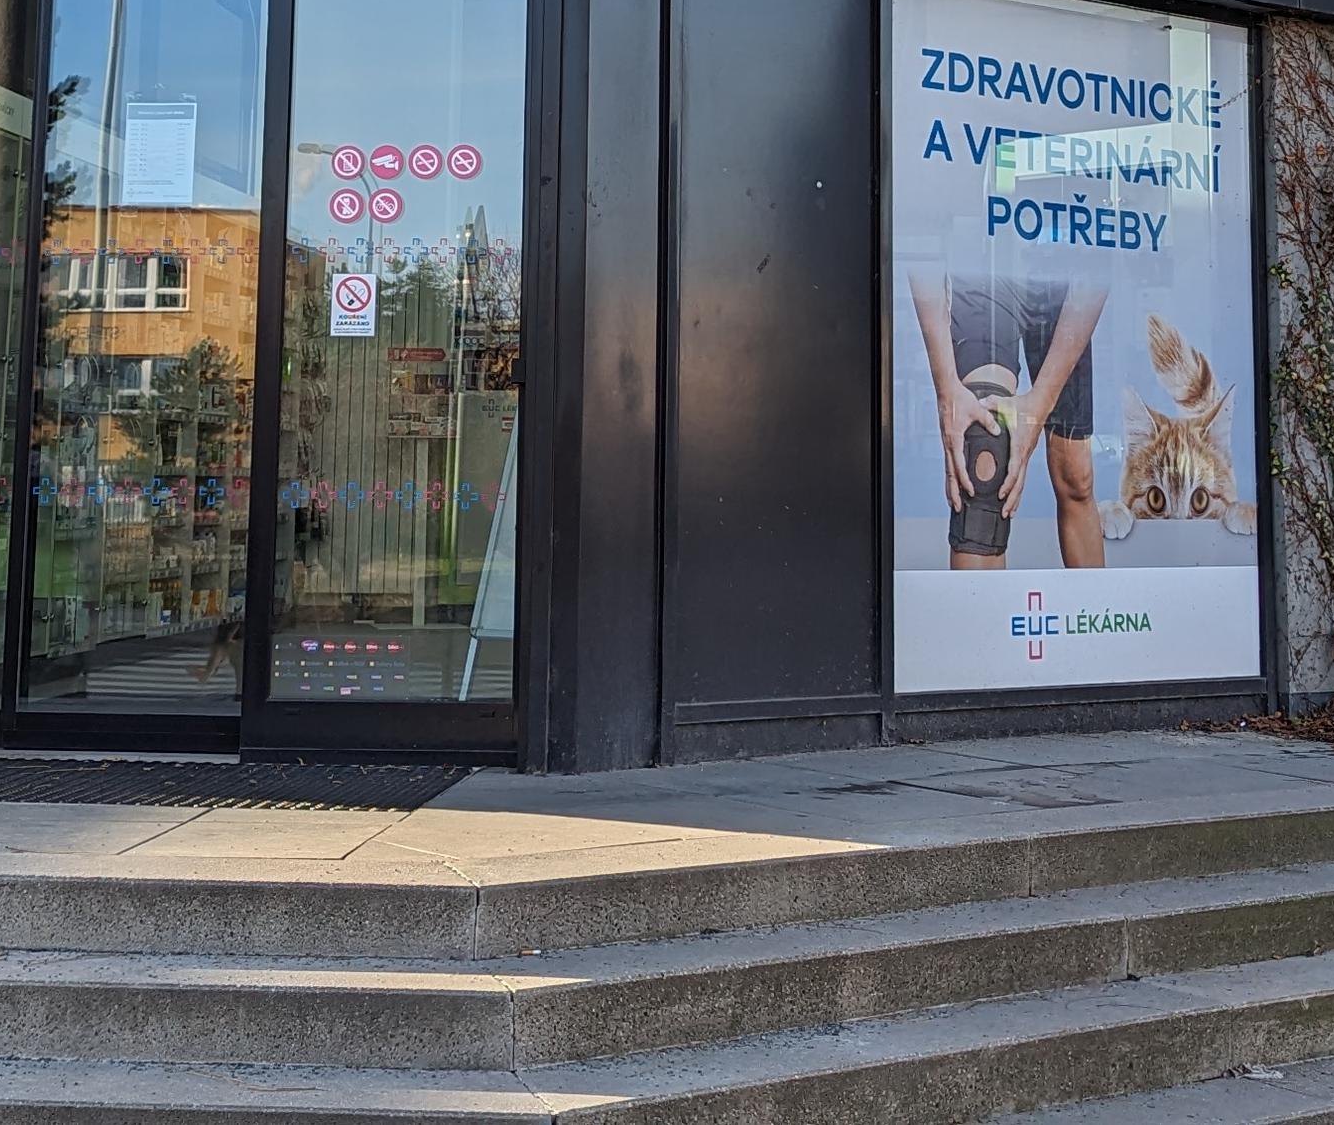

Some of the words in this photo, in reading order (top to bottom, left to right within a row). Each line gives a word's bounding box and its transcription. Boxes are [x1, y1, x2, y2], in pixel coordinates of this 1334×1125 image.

[921, 48, 1221, 129] ZDRAVOTNICKÉ
[923, 119, 953, 162] A
[963, 123, 1220, 193] VETERINÁRNÍ
[987, 194, 1167, 252] POTŘEBY
[1065, 608, 1152, 635] LÉKÁRNA
